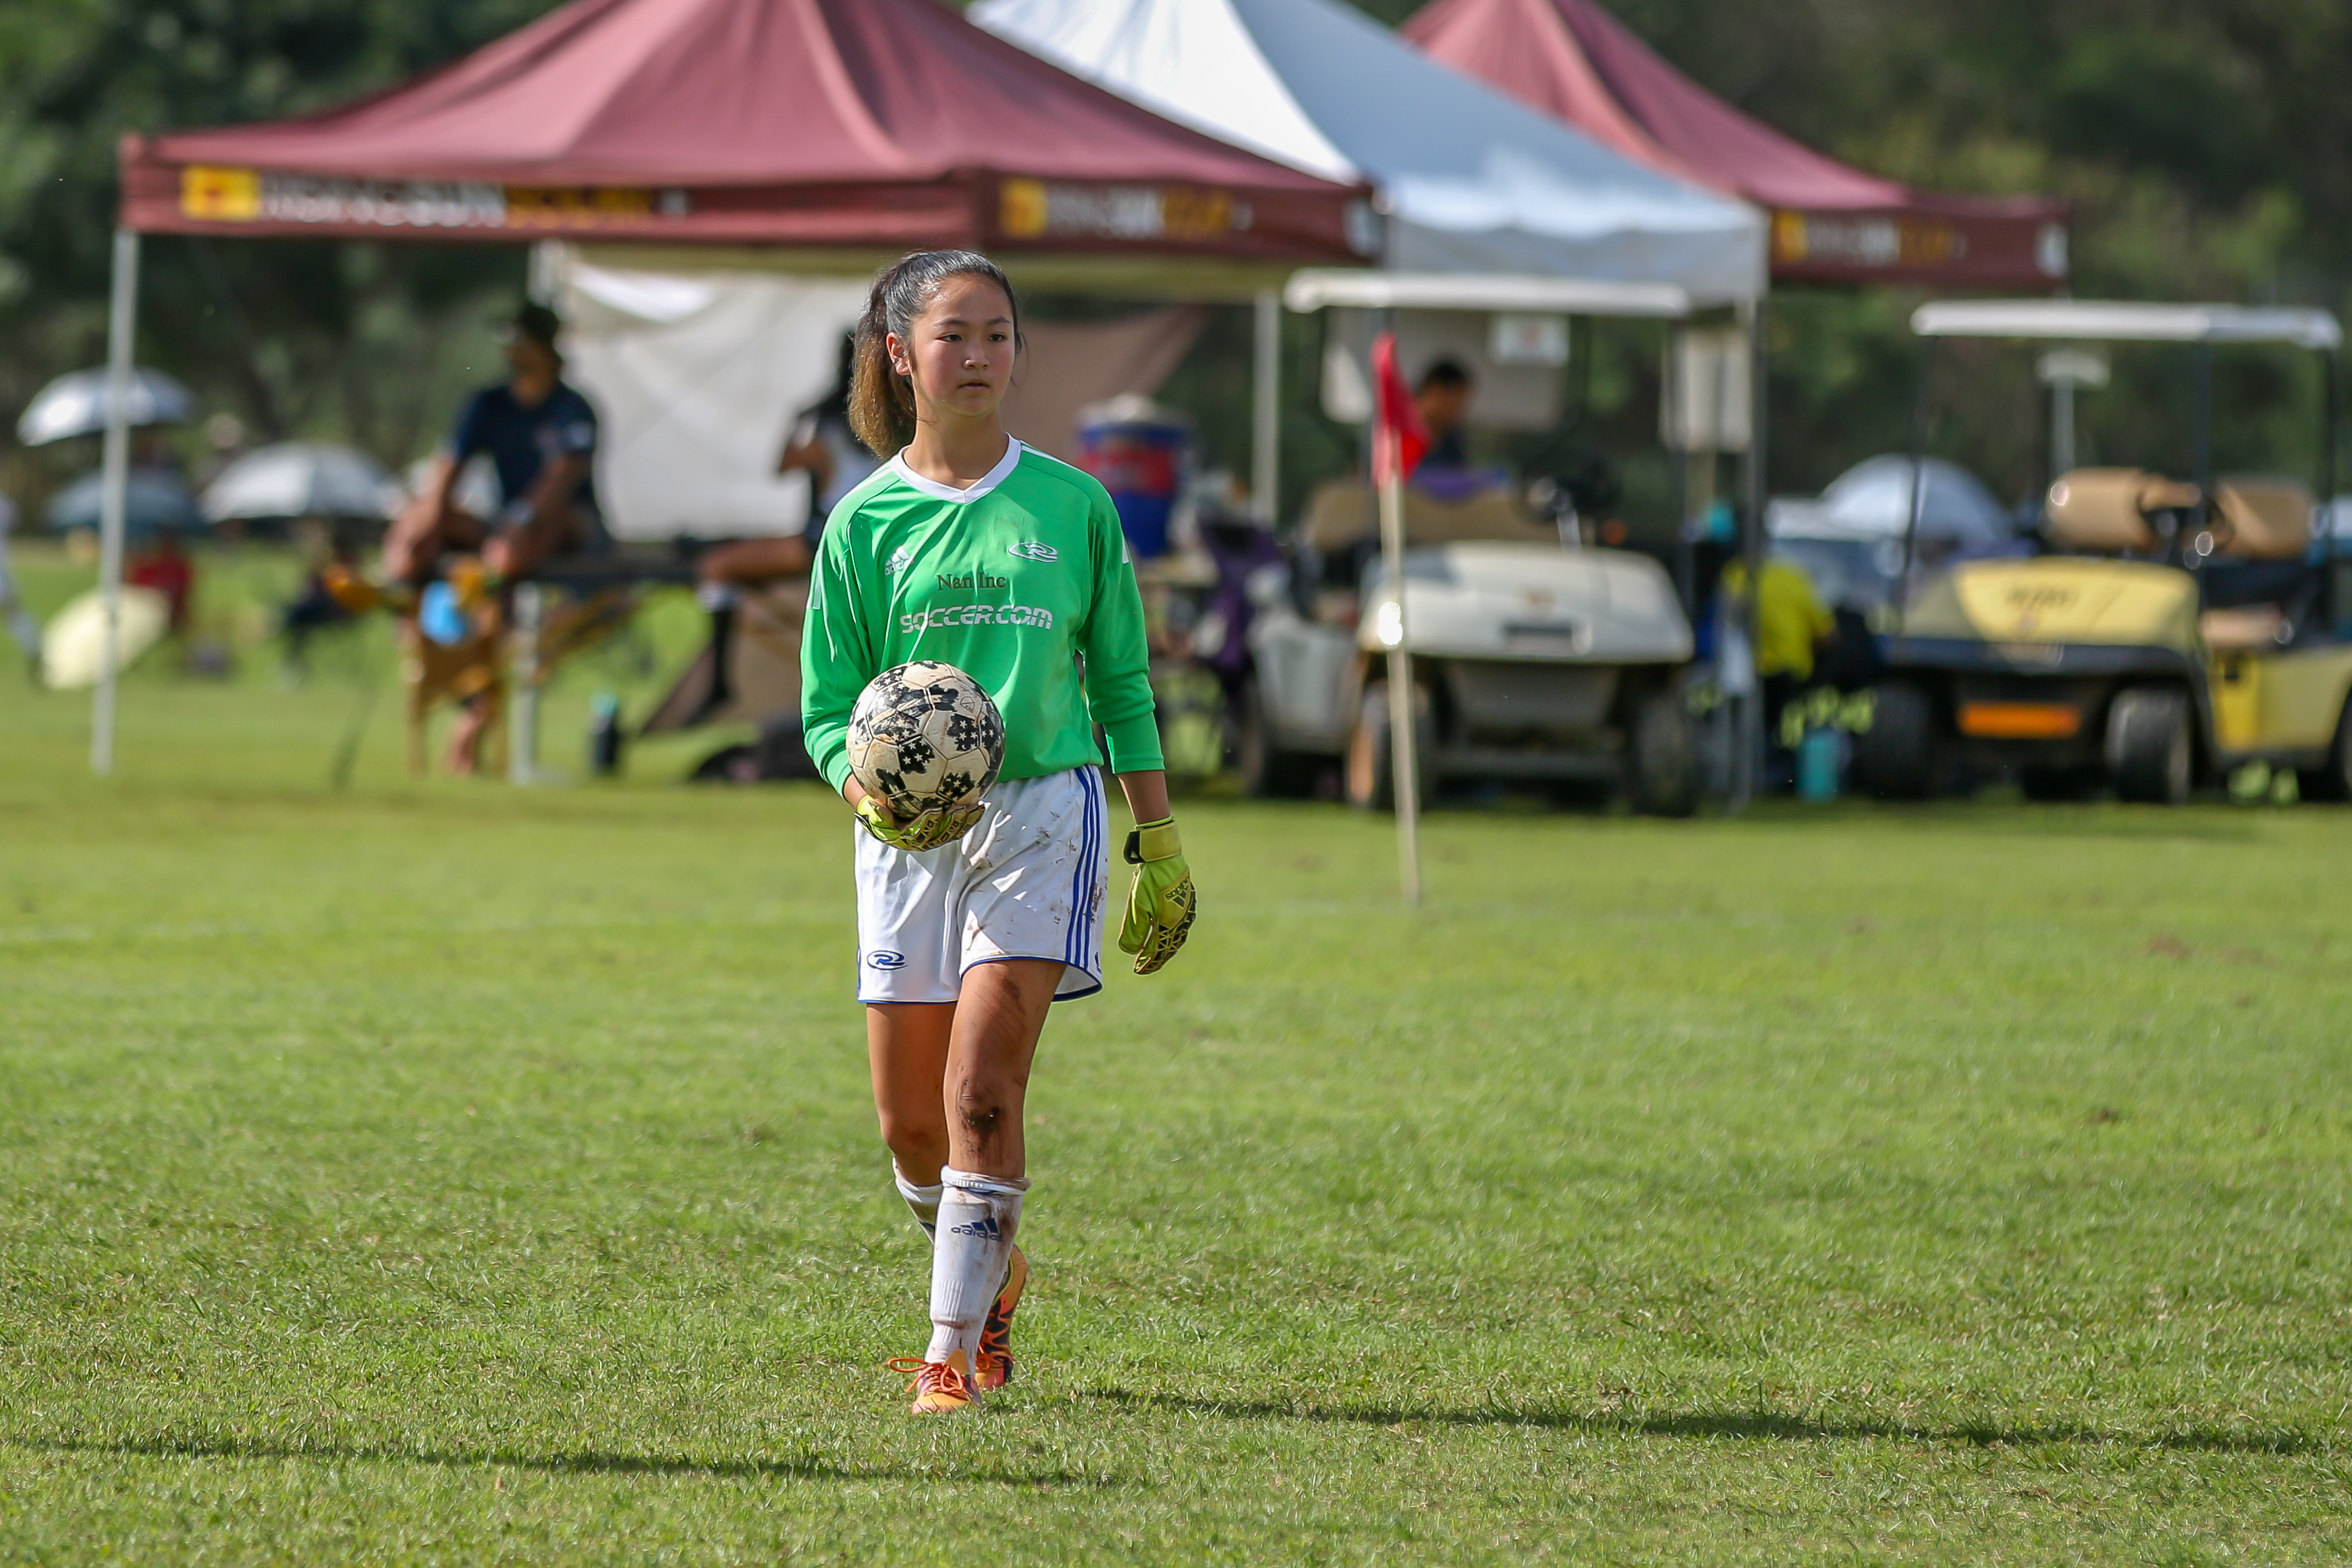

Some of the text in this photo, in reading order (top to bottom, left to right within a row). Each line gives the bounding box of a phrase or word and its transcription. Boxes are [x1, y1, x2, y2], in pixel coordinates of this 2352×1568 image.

[885, 560, 913, 575] adid
[936, 572, 1006, 590] Nan Inc
[951, 1225, 1002, 1242] adidas
